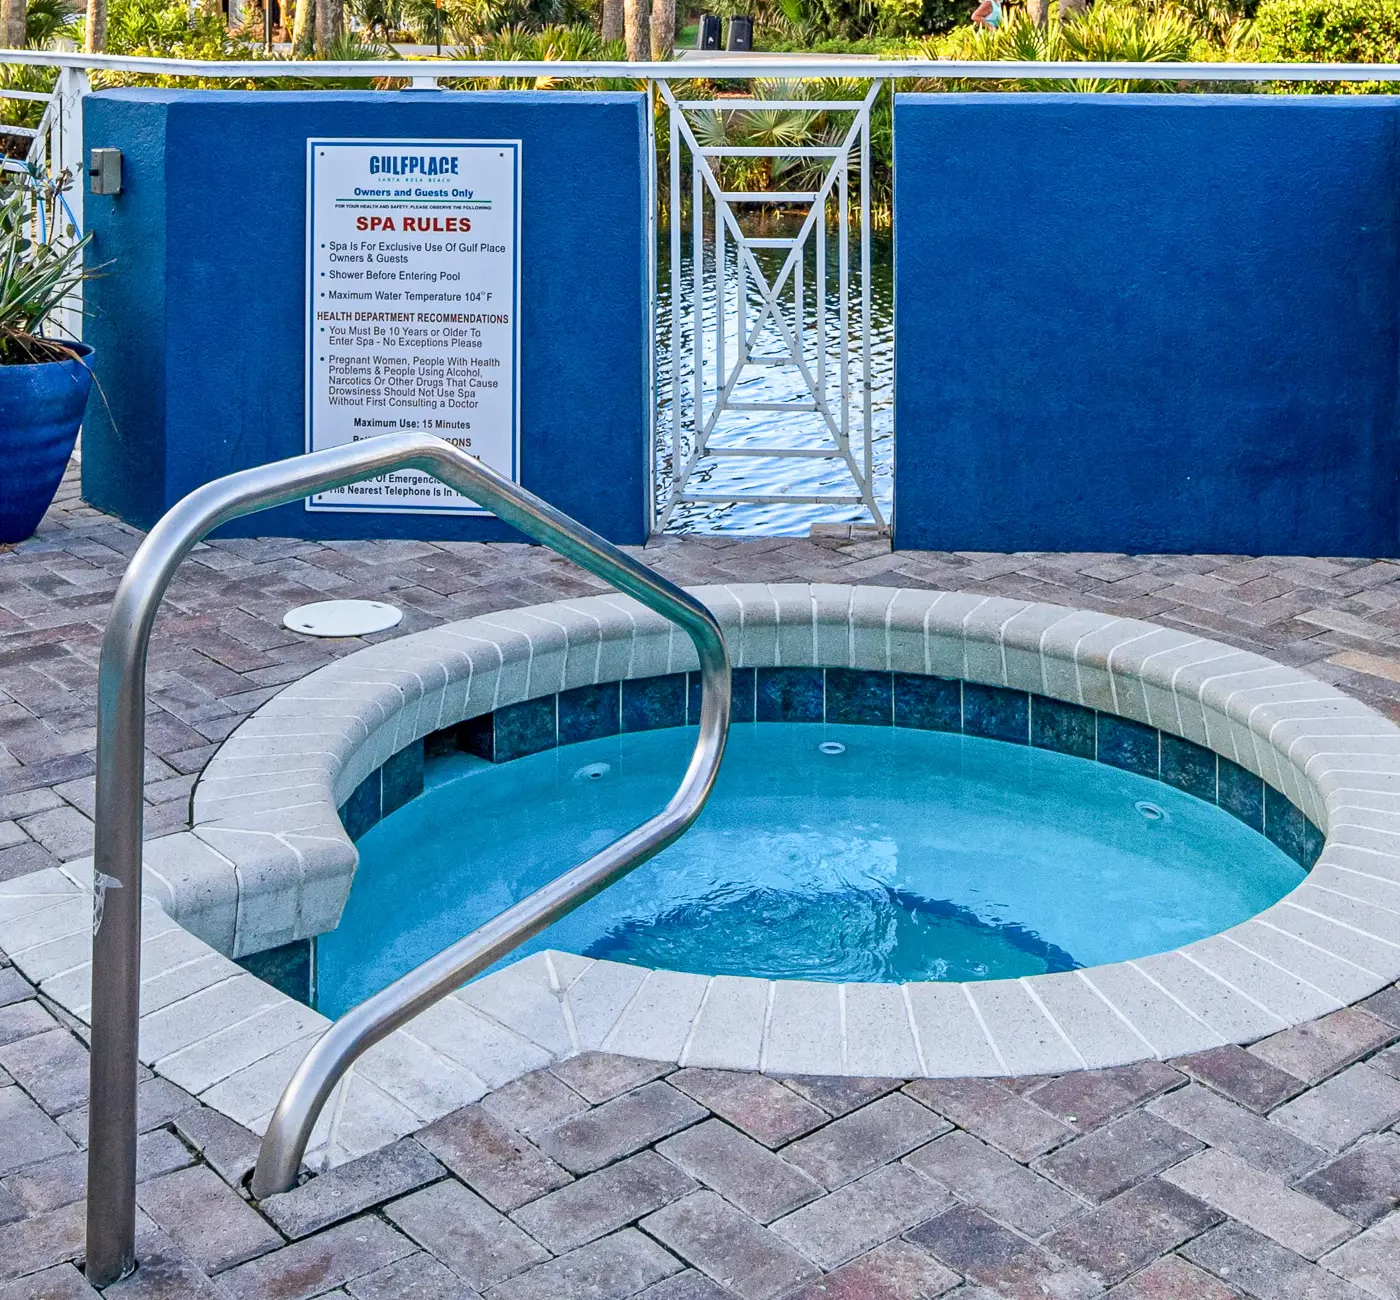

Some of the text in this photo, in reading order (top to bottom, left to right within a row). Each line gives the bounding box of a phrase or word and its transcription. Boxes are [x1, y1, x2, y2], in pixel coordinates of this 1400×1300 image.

[369, 156, 458, 176] GULFPLACE
[354, 188, 473, 199] Owners and Guests Only
[356, 216, 471, 232] SPA RULES
[329, 242, 506, 253] Spa Is For Exclusive Use Of Gulf Place
[329, 254, 408, 263] Owners & Guests
[329, 270, 460, 282] Shower Before Entering Pool
[329, 291, 372, 300] Maximum
[375, 291, 402, 300] Water
[405, 292, 462, 302] Temperature
[317, 312, 509, 324] HEALTH DEPARTMENT RECOMMENDATIONS
[329, 326, 481, 337] You Must Be 10 Years or Older To
[329, 337, 353, 346] Enter
[356, 337, 374, 347] Spa
[383, 338, 396, 347] No
[399, 338, 449, 348] Exceptions
[451, 338, 482, 347] Please
[329, 355, 500, 368] Pregnant Women, People With Health
[329, 366, 483, 378] Problems & People Using Alcohol,
[329, 376, 498, 388] Narcotics Or Other Drugs That Cause
[329, 387, 476, 399] Drowsiness Should Not Use Spa
[329, 397, 363, 407] Without
[366, 398, 386, 407] First
[389, 398, 437, 409] Consulting
[448, 399, 478, 409] Doctor
[354, 418, 471, 430] Maximum Use: 15 Minutes
[376, 475, 386, 483] Of
[348, 486, 382, 495] Nearest
[385, 487, 430, 498] Telephone
[433, 488, 441, 497] Is
[443, 488, 452, 497] In
